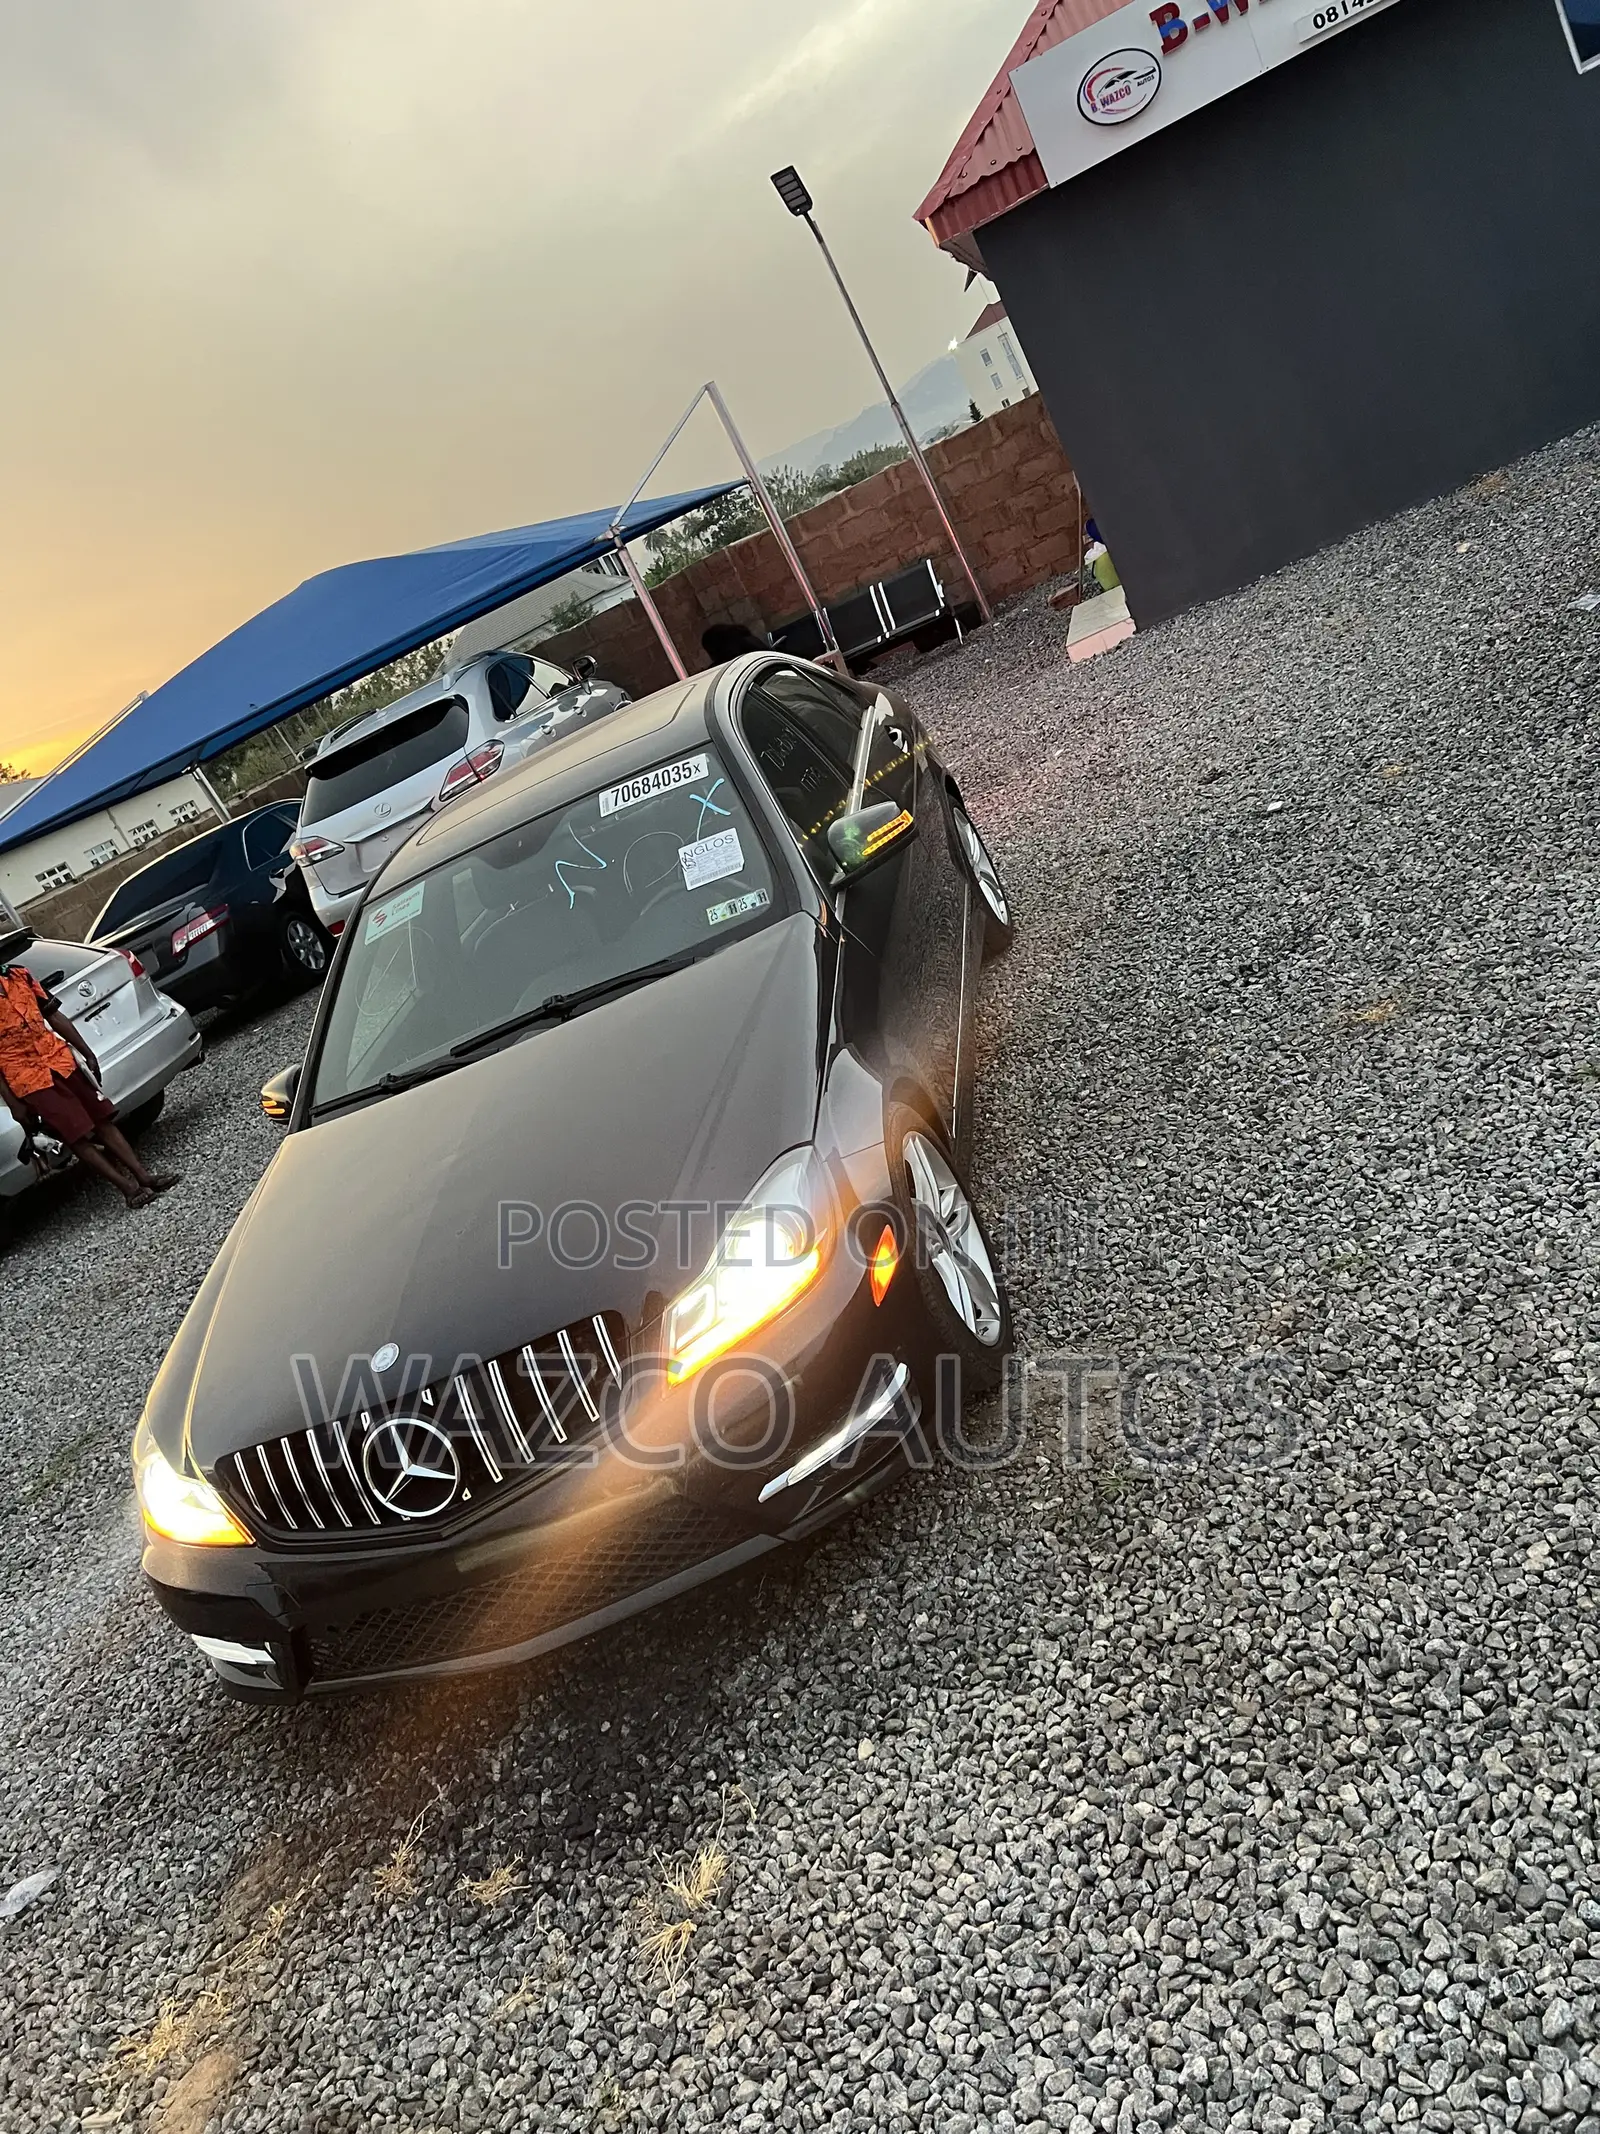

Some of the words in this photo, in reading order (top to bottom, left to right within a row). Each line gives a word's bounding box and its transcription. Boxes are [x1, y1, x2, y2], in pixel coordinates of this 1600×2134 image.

[1313, 0, 1374, 29] 0814
[1137, 75, 1155, 87] AUTOS
[1100, 85, 1131, 108] WAZCO
